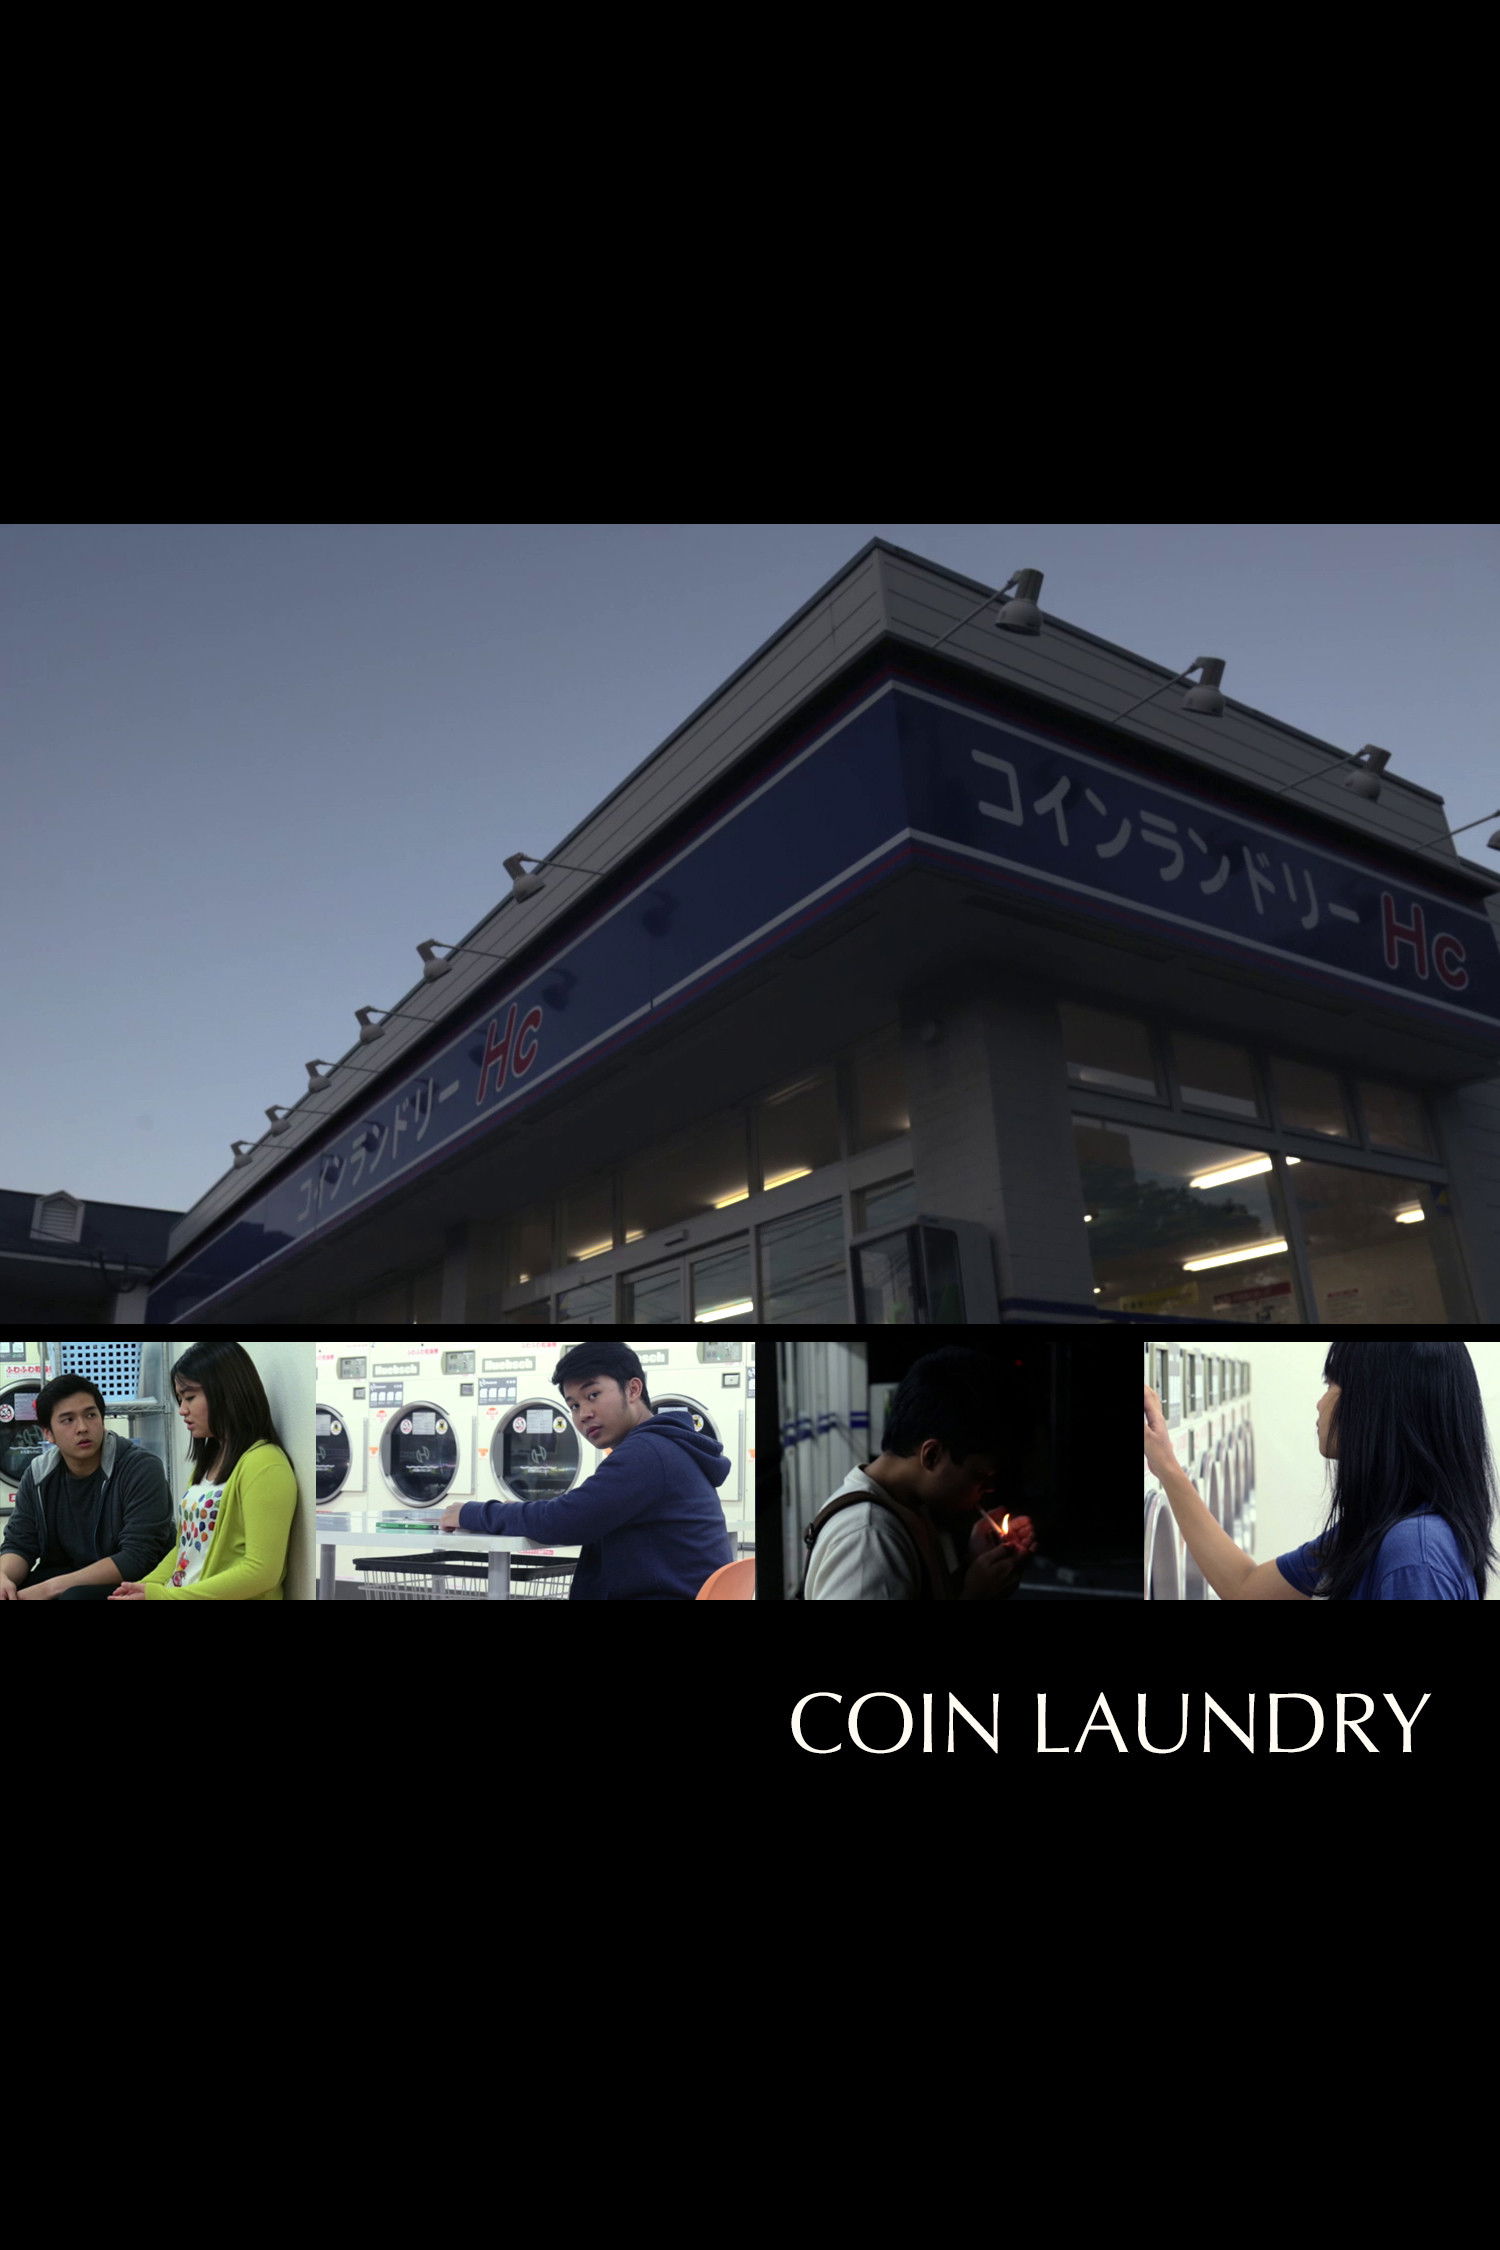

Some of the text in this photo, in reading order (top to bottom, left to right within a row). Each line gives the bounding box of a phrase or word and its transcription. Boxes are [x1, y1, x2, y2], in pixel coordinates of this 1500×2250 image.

[970, 749, 1360, 931] コインランドリー
[297, 1078, 460, 1222] コインランドリー
